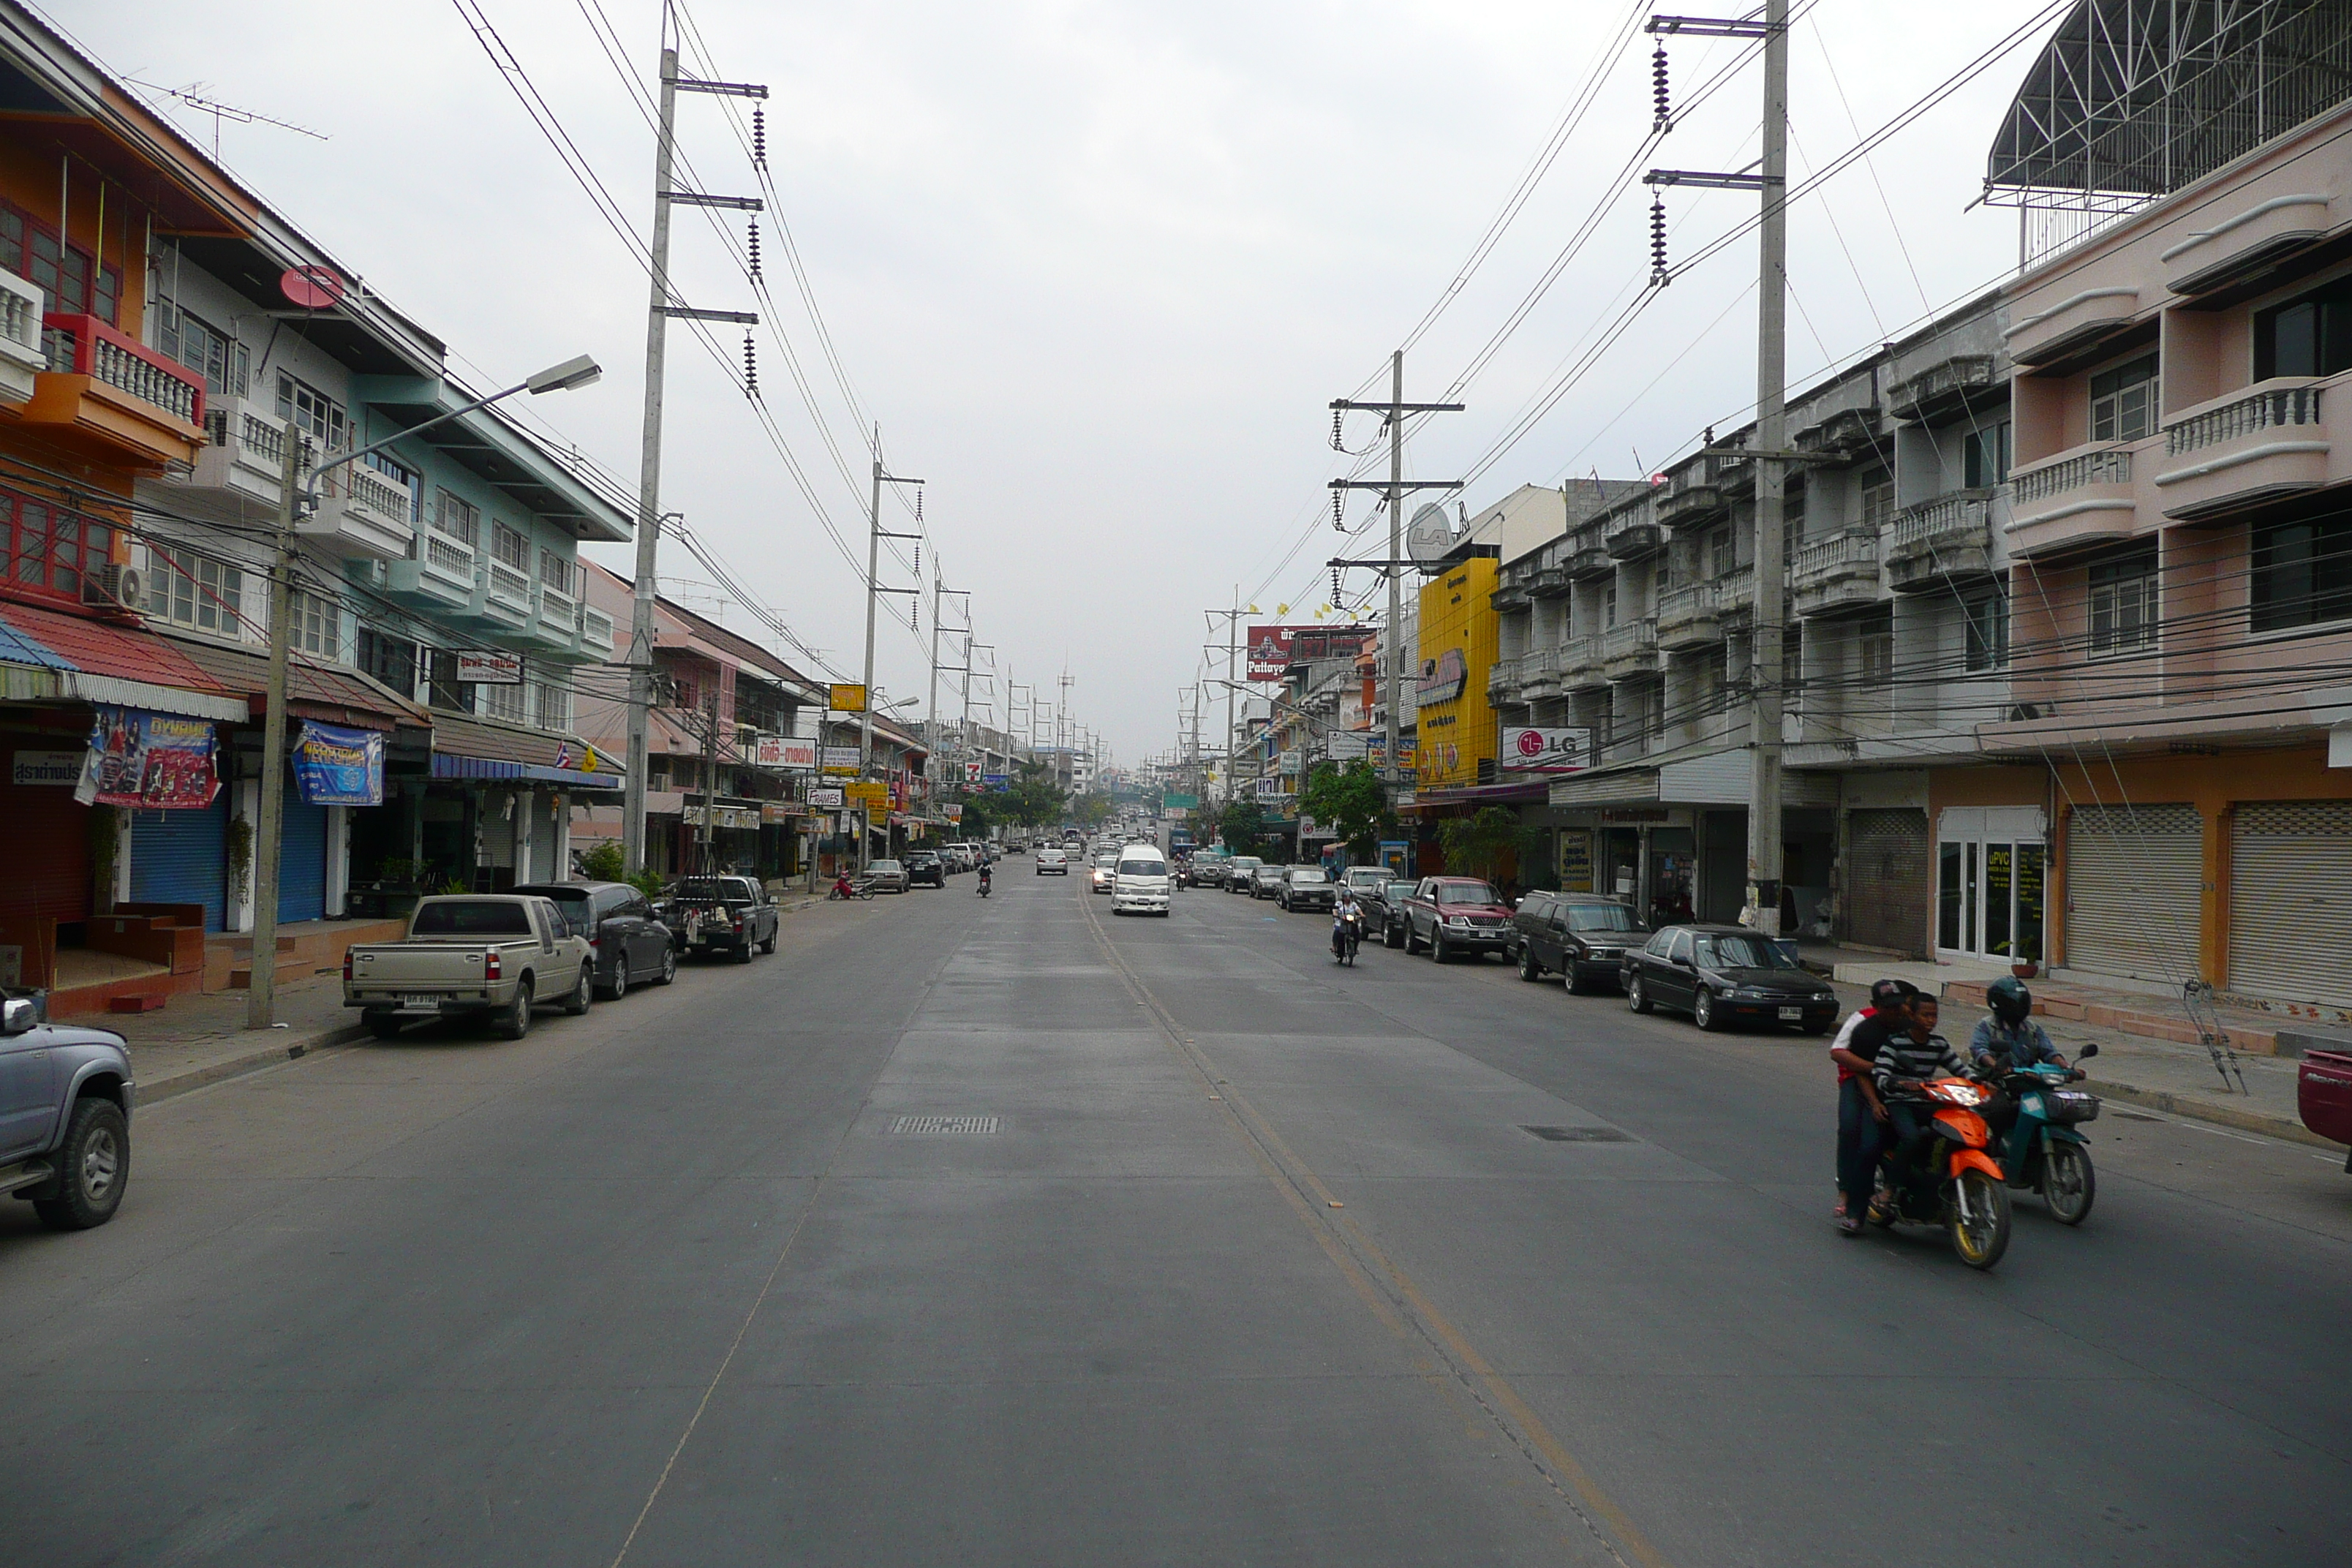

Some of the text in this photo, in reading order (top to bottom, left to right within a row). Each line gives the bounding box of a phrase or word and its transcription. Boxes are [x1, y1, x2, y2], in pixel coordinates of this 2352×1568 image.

[1411, 527, 1449, 546] LA
[1550, 736, 1576, 753] LG
[809, 791, 839, 804] FRAMES
[1989, 851, 2010, 865] uPVC
